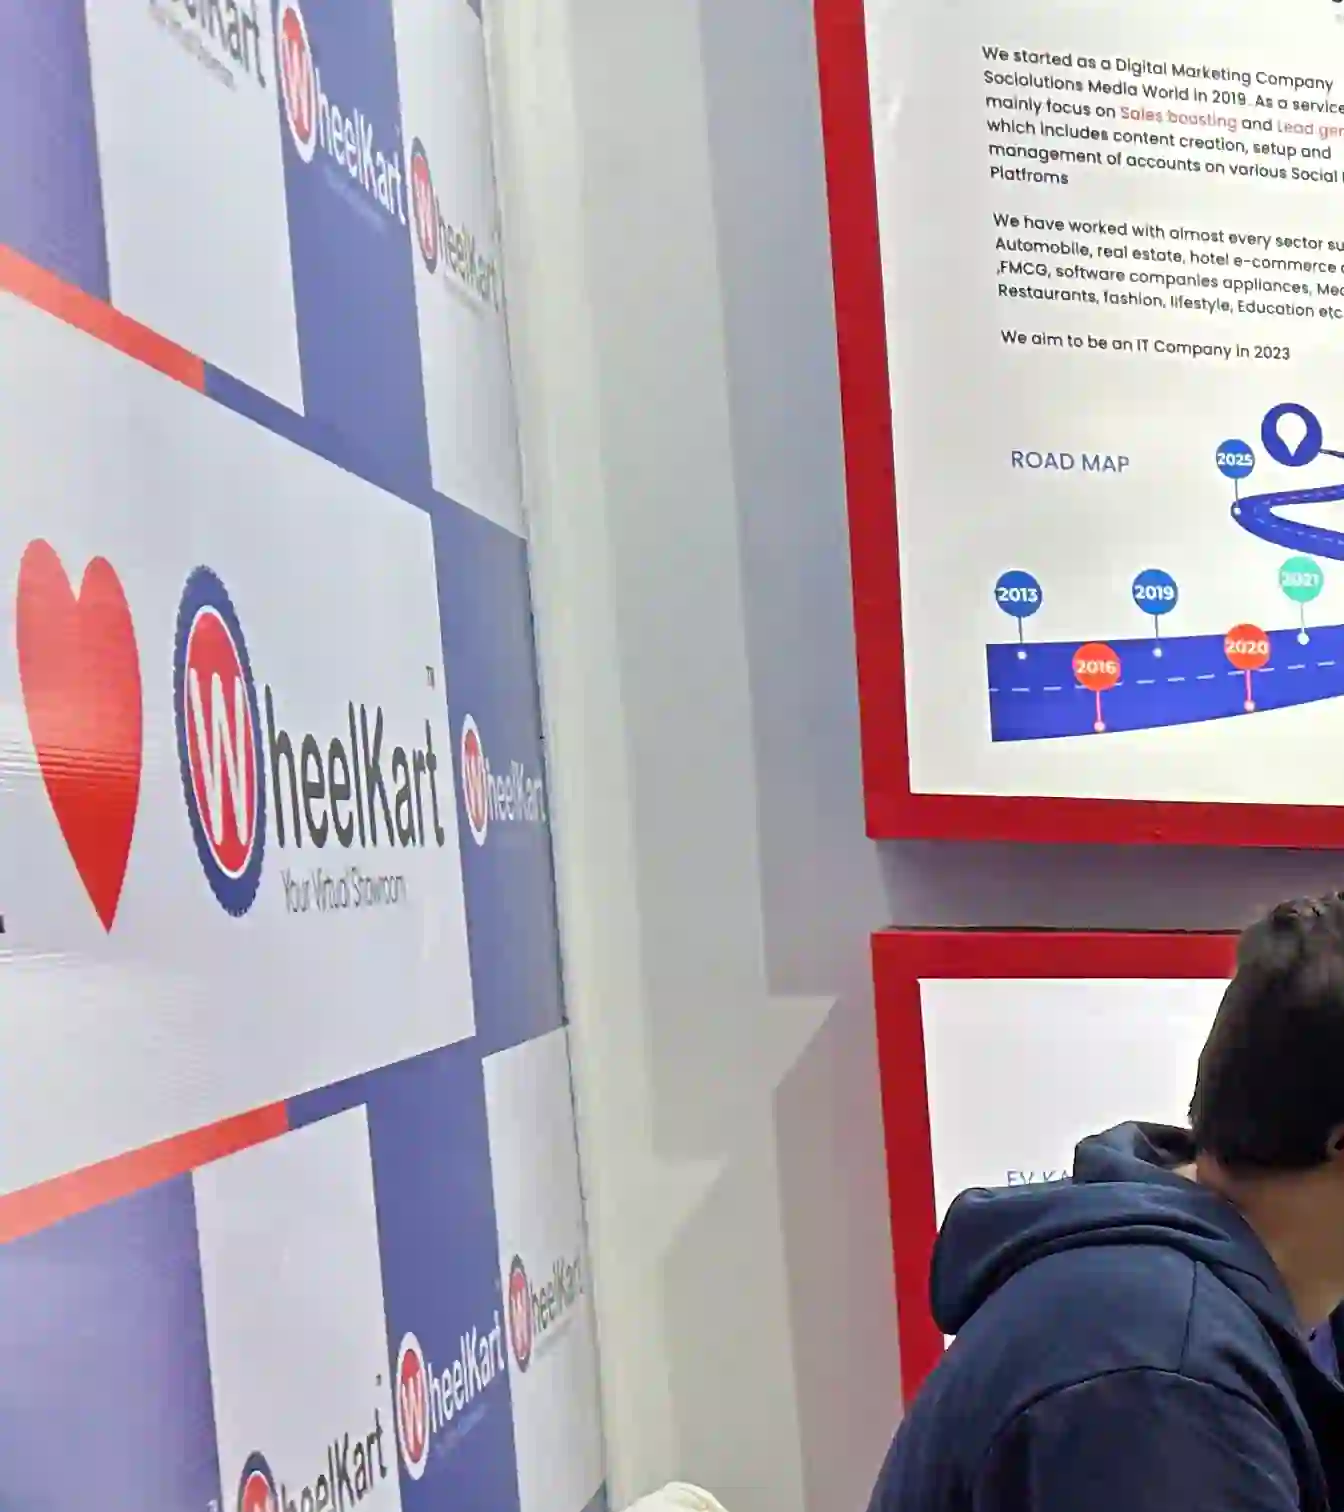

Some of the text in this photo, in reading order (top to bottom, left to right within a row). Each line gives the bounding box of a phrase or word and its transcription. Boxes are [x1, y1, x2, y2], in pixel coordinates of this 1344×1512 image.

[982, 46, 1333, 94] We started as a Digital Marketing Company
[984, 70, 1083, 92] Sociolutions
[1088, 80, 1138, 96] Media
[1142, 84, 1189, 100] World
[1194, 88, 1207, 102] in
[1255, 95, 1273, 108] As
[1278, 99, 1288, 109] a
[993, 212, 1020, 228] We
[1024, 215, 1064, 231] have
[1068, 220, 1128, 236] worked
[1132, 225, 1165, 239] with
[1170, 227, 1224, 243] almost
[1228, 234, 1271, 250] every
[1276, 237, 1323, 250] sector
[1001, 330, 1290, 360] We aim to be an IT Company in 2023
[1011, 451, 1129, 472] ROAD MAP
[1217, 452, 1253, 467] 2025
[996, 586, 1038, 603] 2013
[1135, 584, 1174, 600] 2019
[1225, 639, 1268, 656] 2020
[1075, 659, 1117, 676] 2016
[187, 667, 444, 849] WheelKart
[280, 865, 407, 913] Your Virtual Showroom
